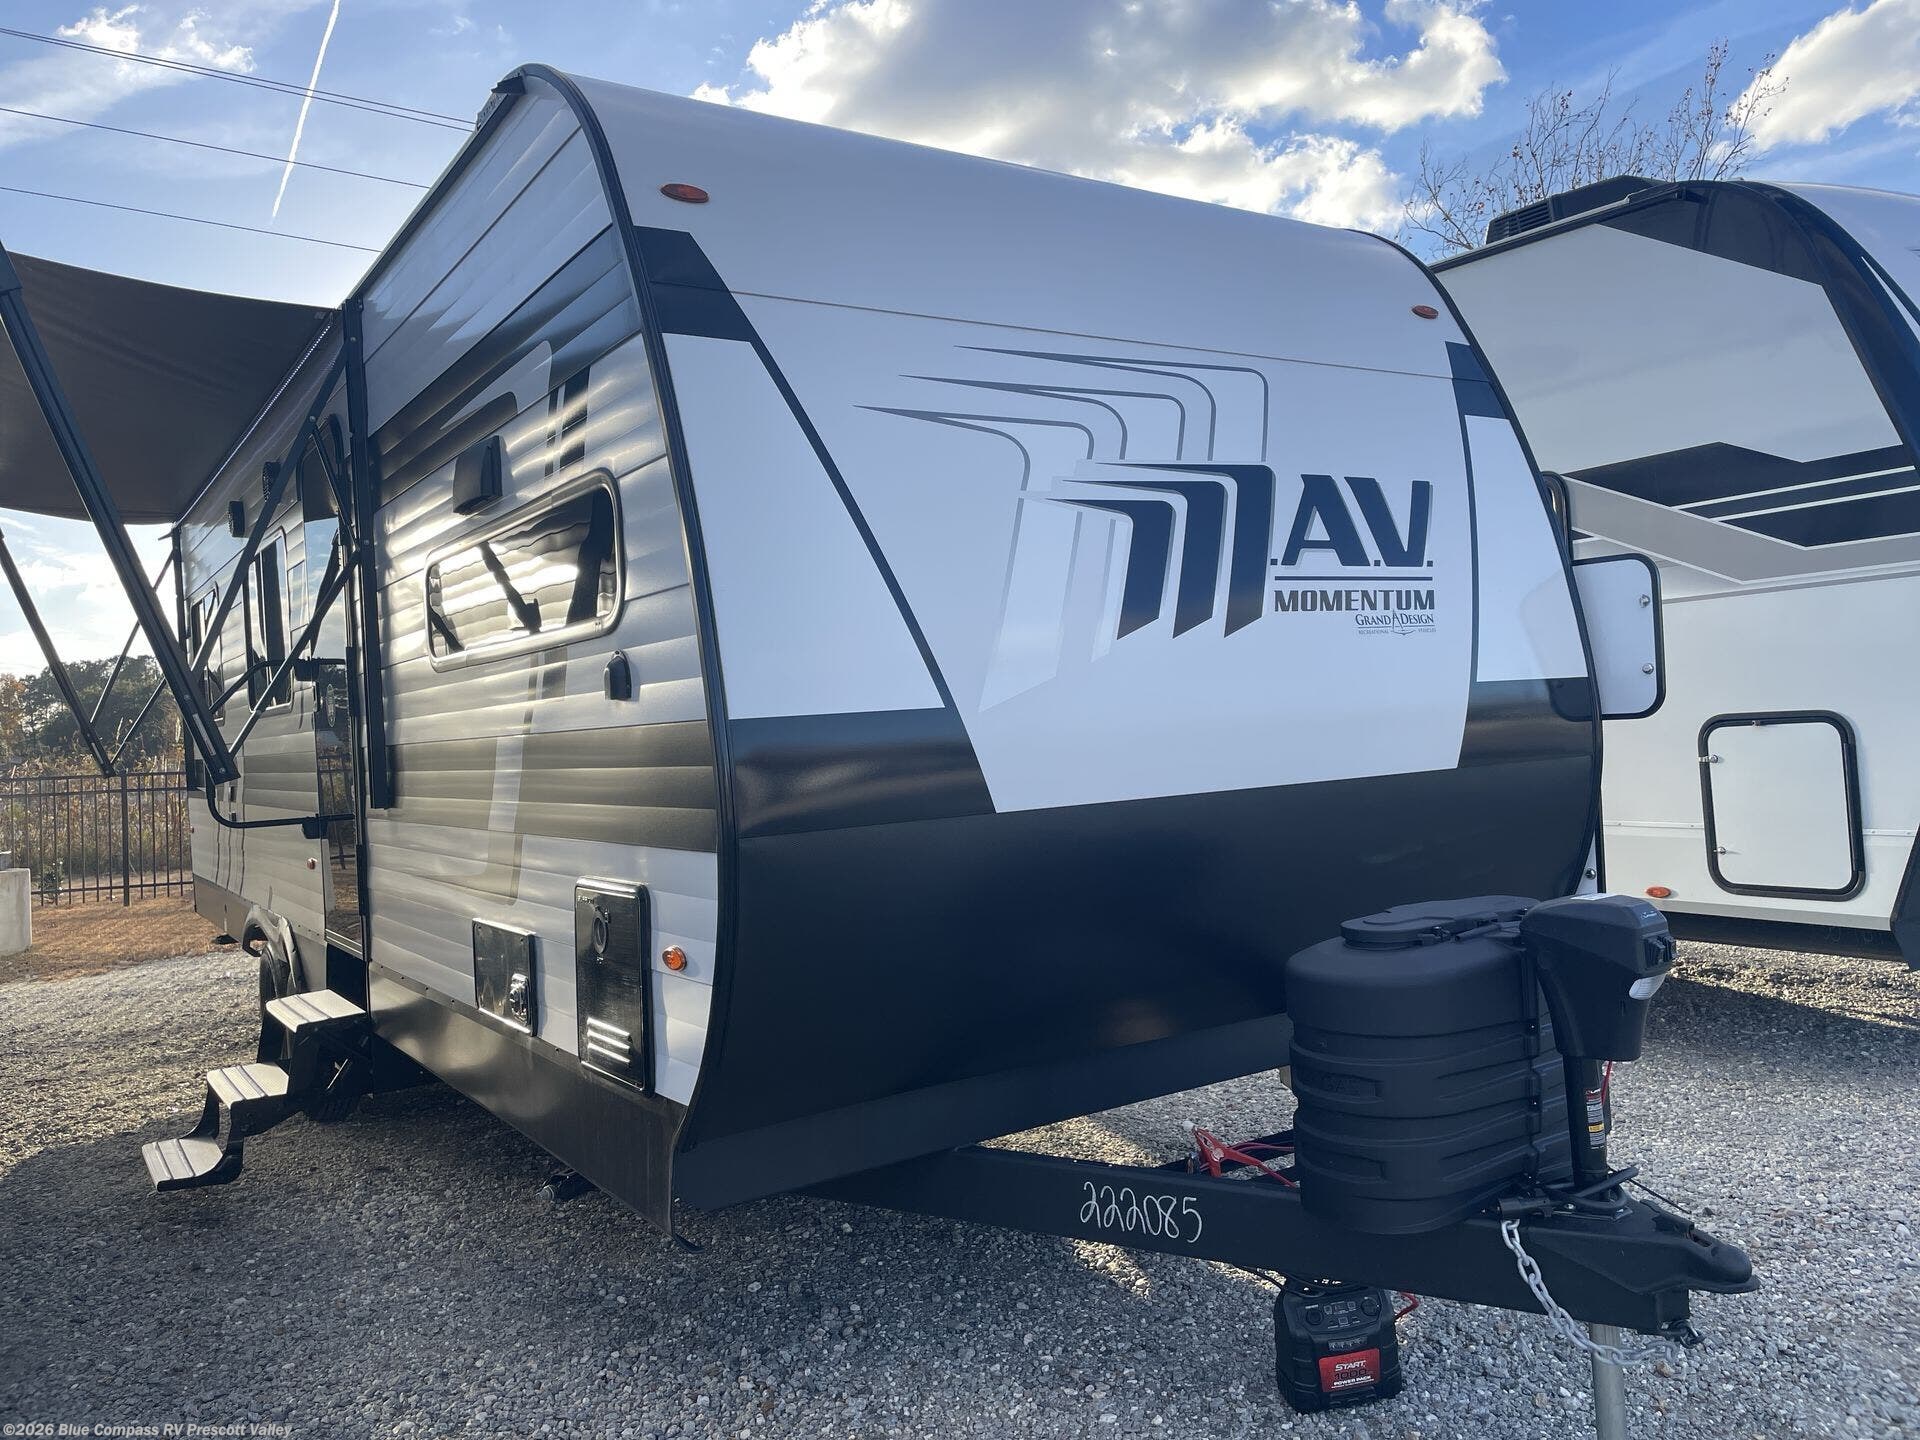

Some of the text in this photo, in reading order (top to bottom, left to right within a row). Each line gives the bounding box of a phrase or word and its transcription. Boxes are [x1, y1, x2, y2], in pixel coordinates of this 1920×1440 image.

[1274, 589, 1435, 612] MOMENTUM
[1355, 613, 1434, 626] GRAND DESIGN
[1080, 1181, 1202, 1243] 222085
[1335, 1360, 1367, 1371] START
